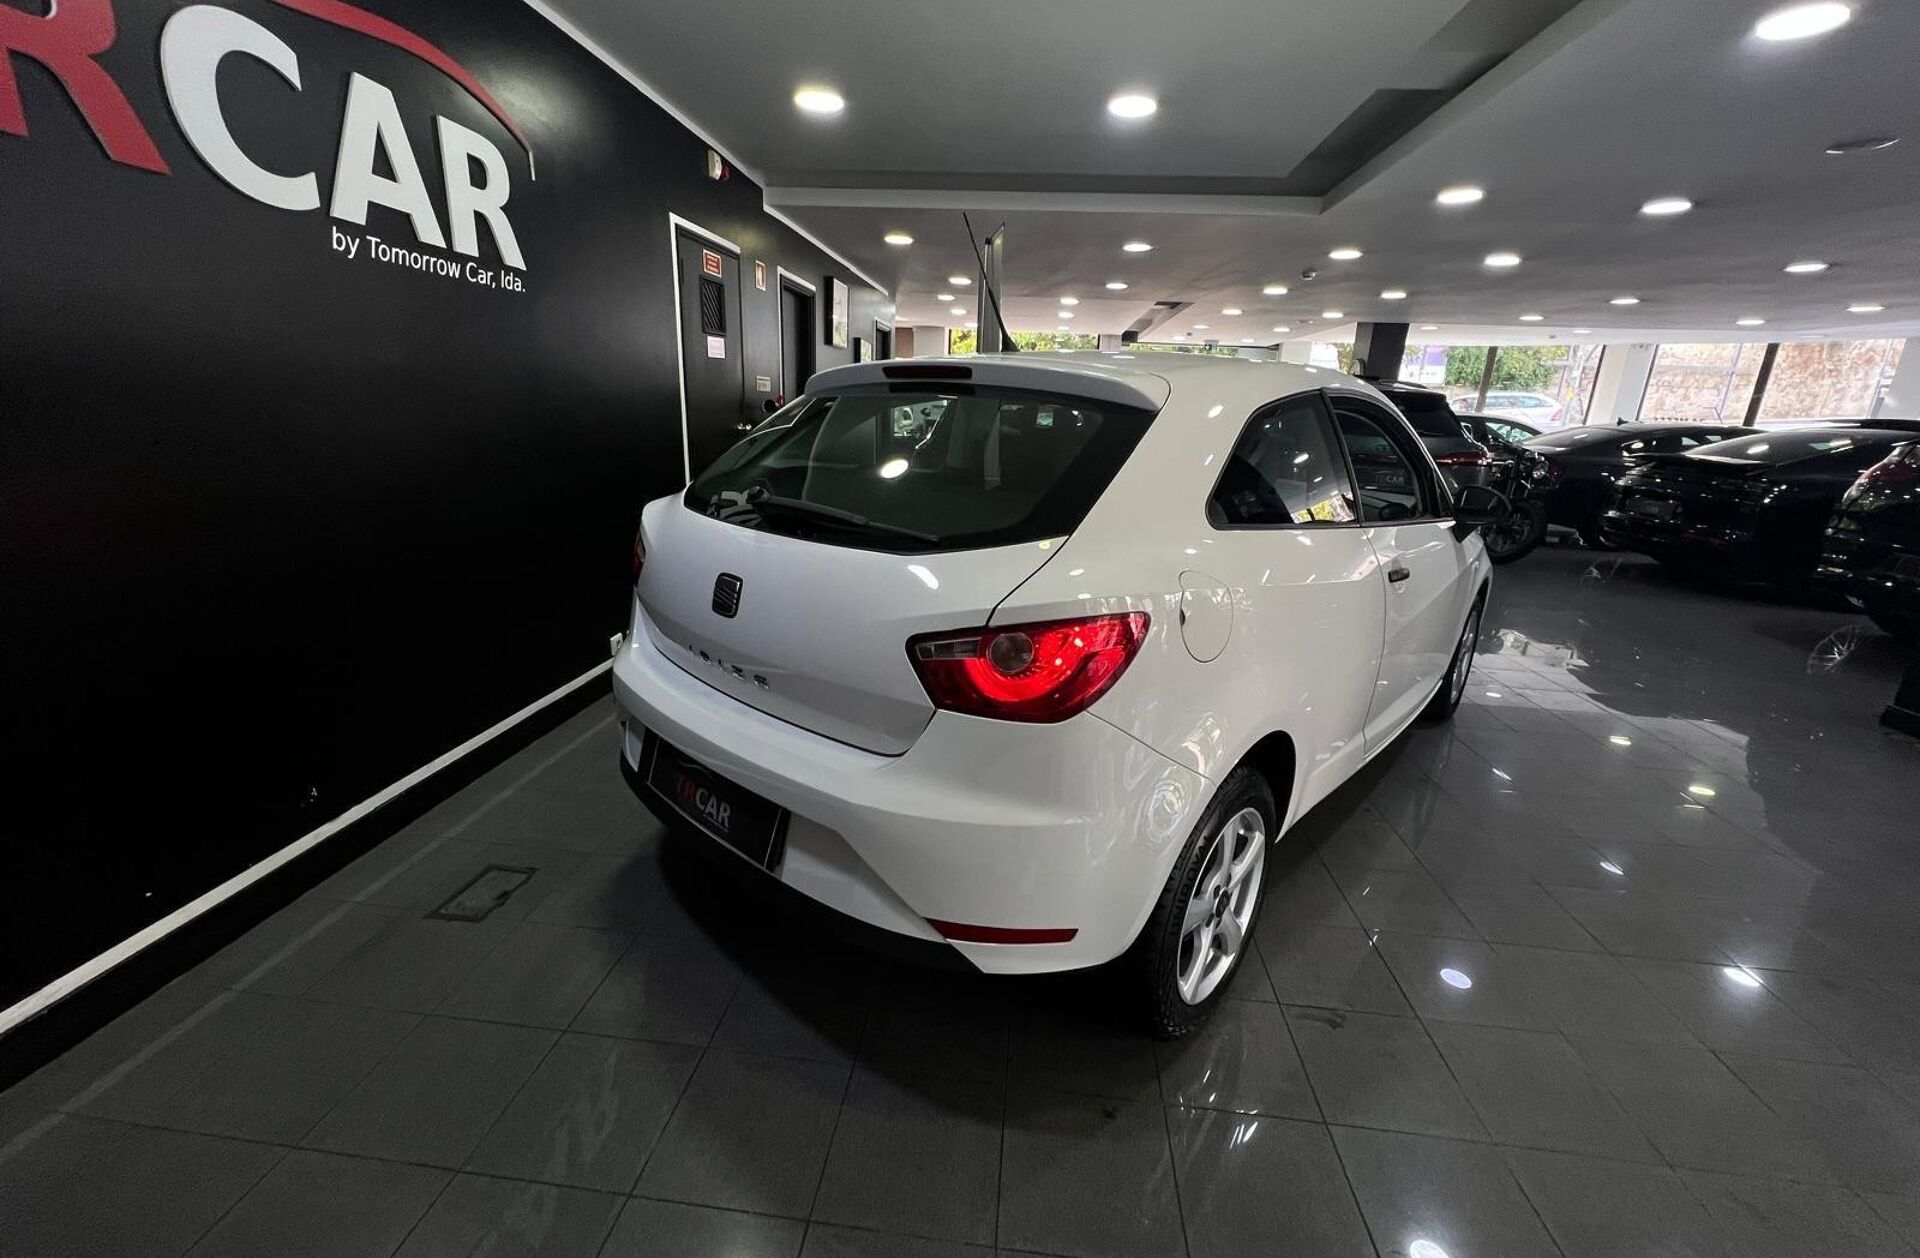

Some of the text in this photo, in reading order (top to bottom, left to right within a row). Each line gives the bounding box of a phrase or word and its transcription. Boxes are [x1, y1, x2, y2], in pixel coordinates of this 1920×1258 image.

[332, 226, 360, 258] by
[366, 235, 461, 279] Tomorrow
[466, 262, 496, 289] Car,
